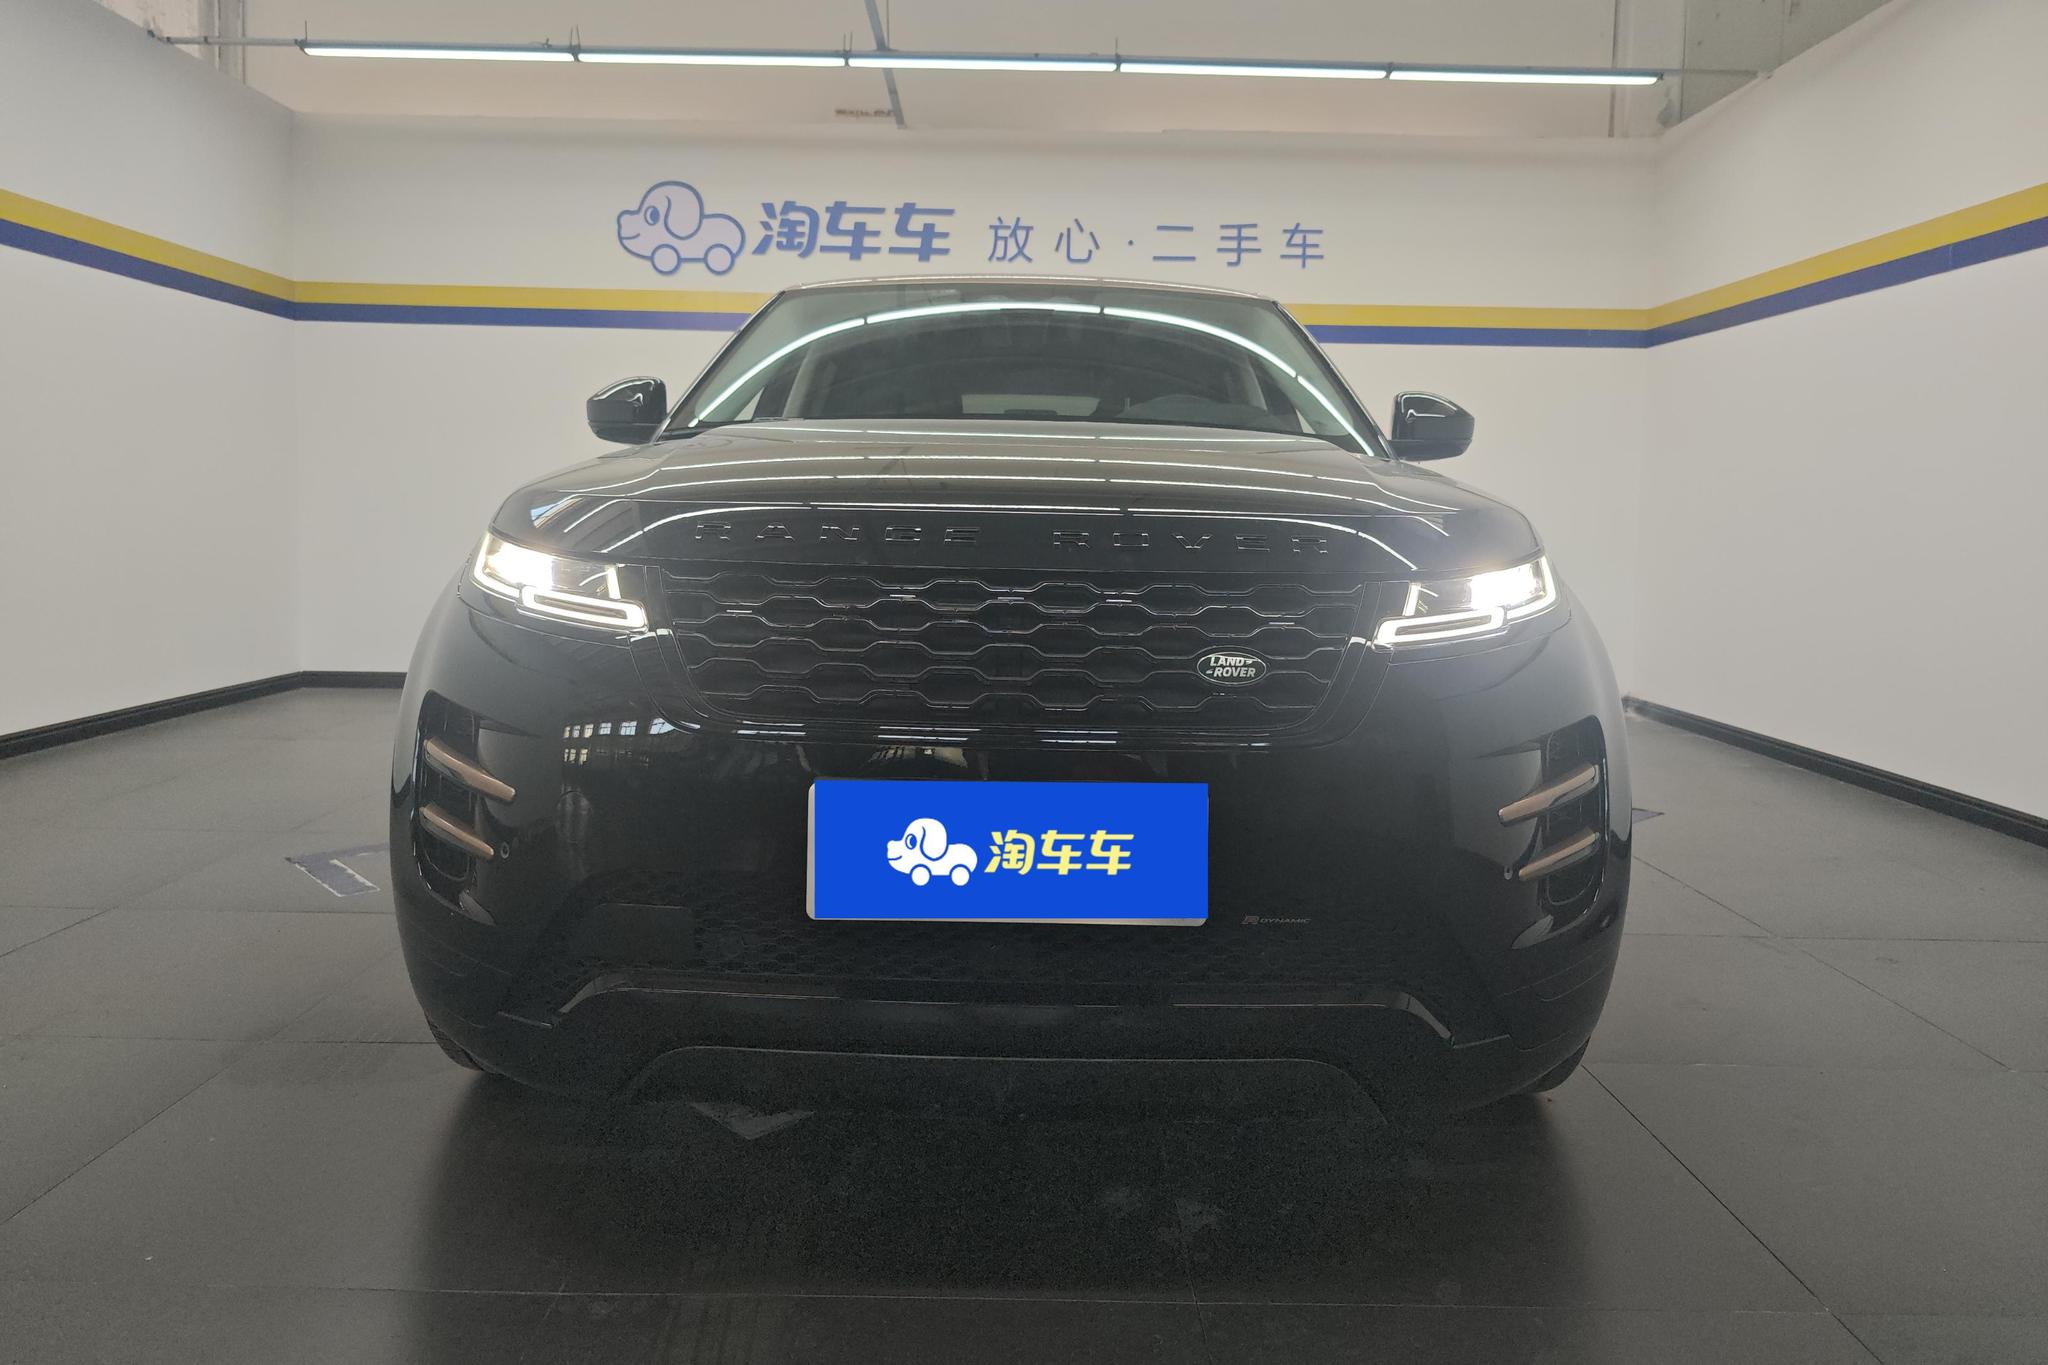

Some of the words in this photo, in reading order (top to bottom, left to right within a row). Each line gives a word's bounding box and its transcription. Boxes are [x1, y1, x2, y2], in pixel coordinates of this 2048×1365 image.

[752, 201, 955, 262] 淘车车
[694, 521, 980, 544] RANGE
[1052, 529, 1329, 554] ROVER
[1210, 656, 1244, 667] LAND
[1213, 667, 1256, 678] ROVER
